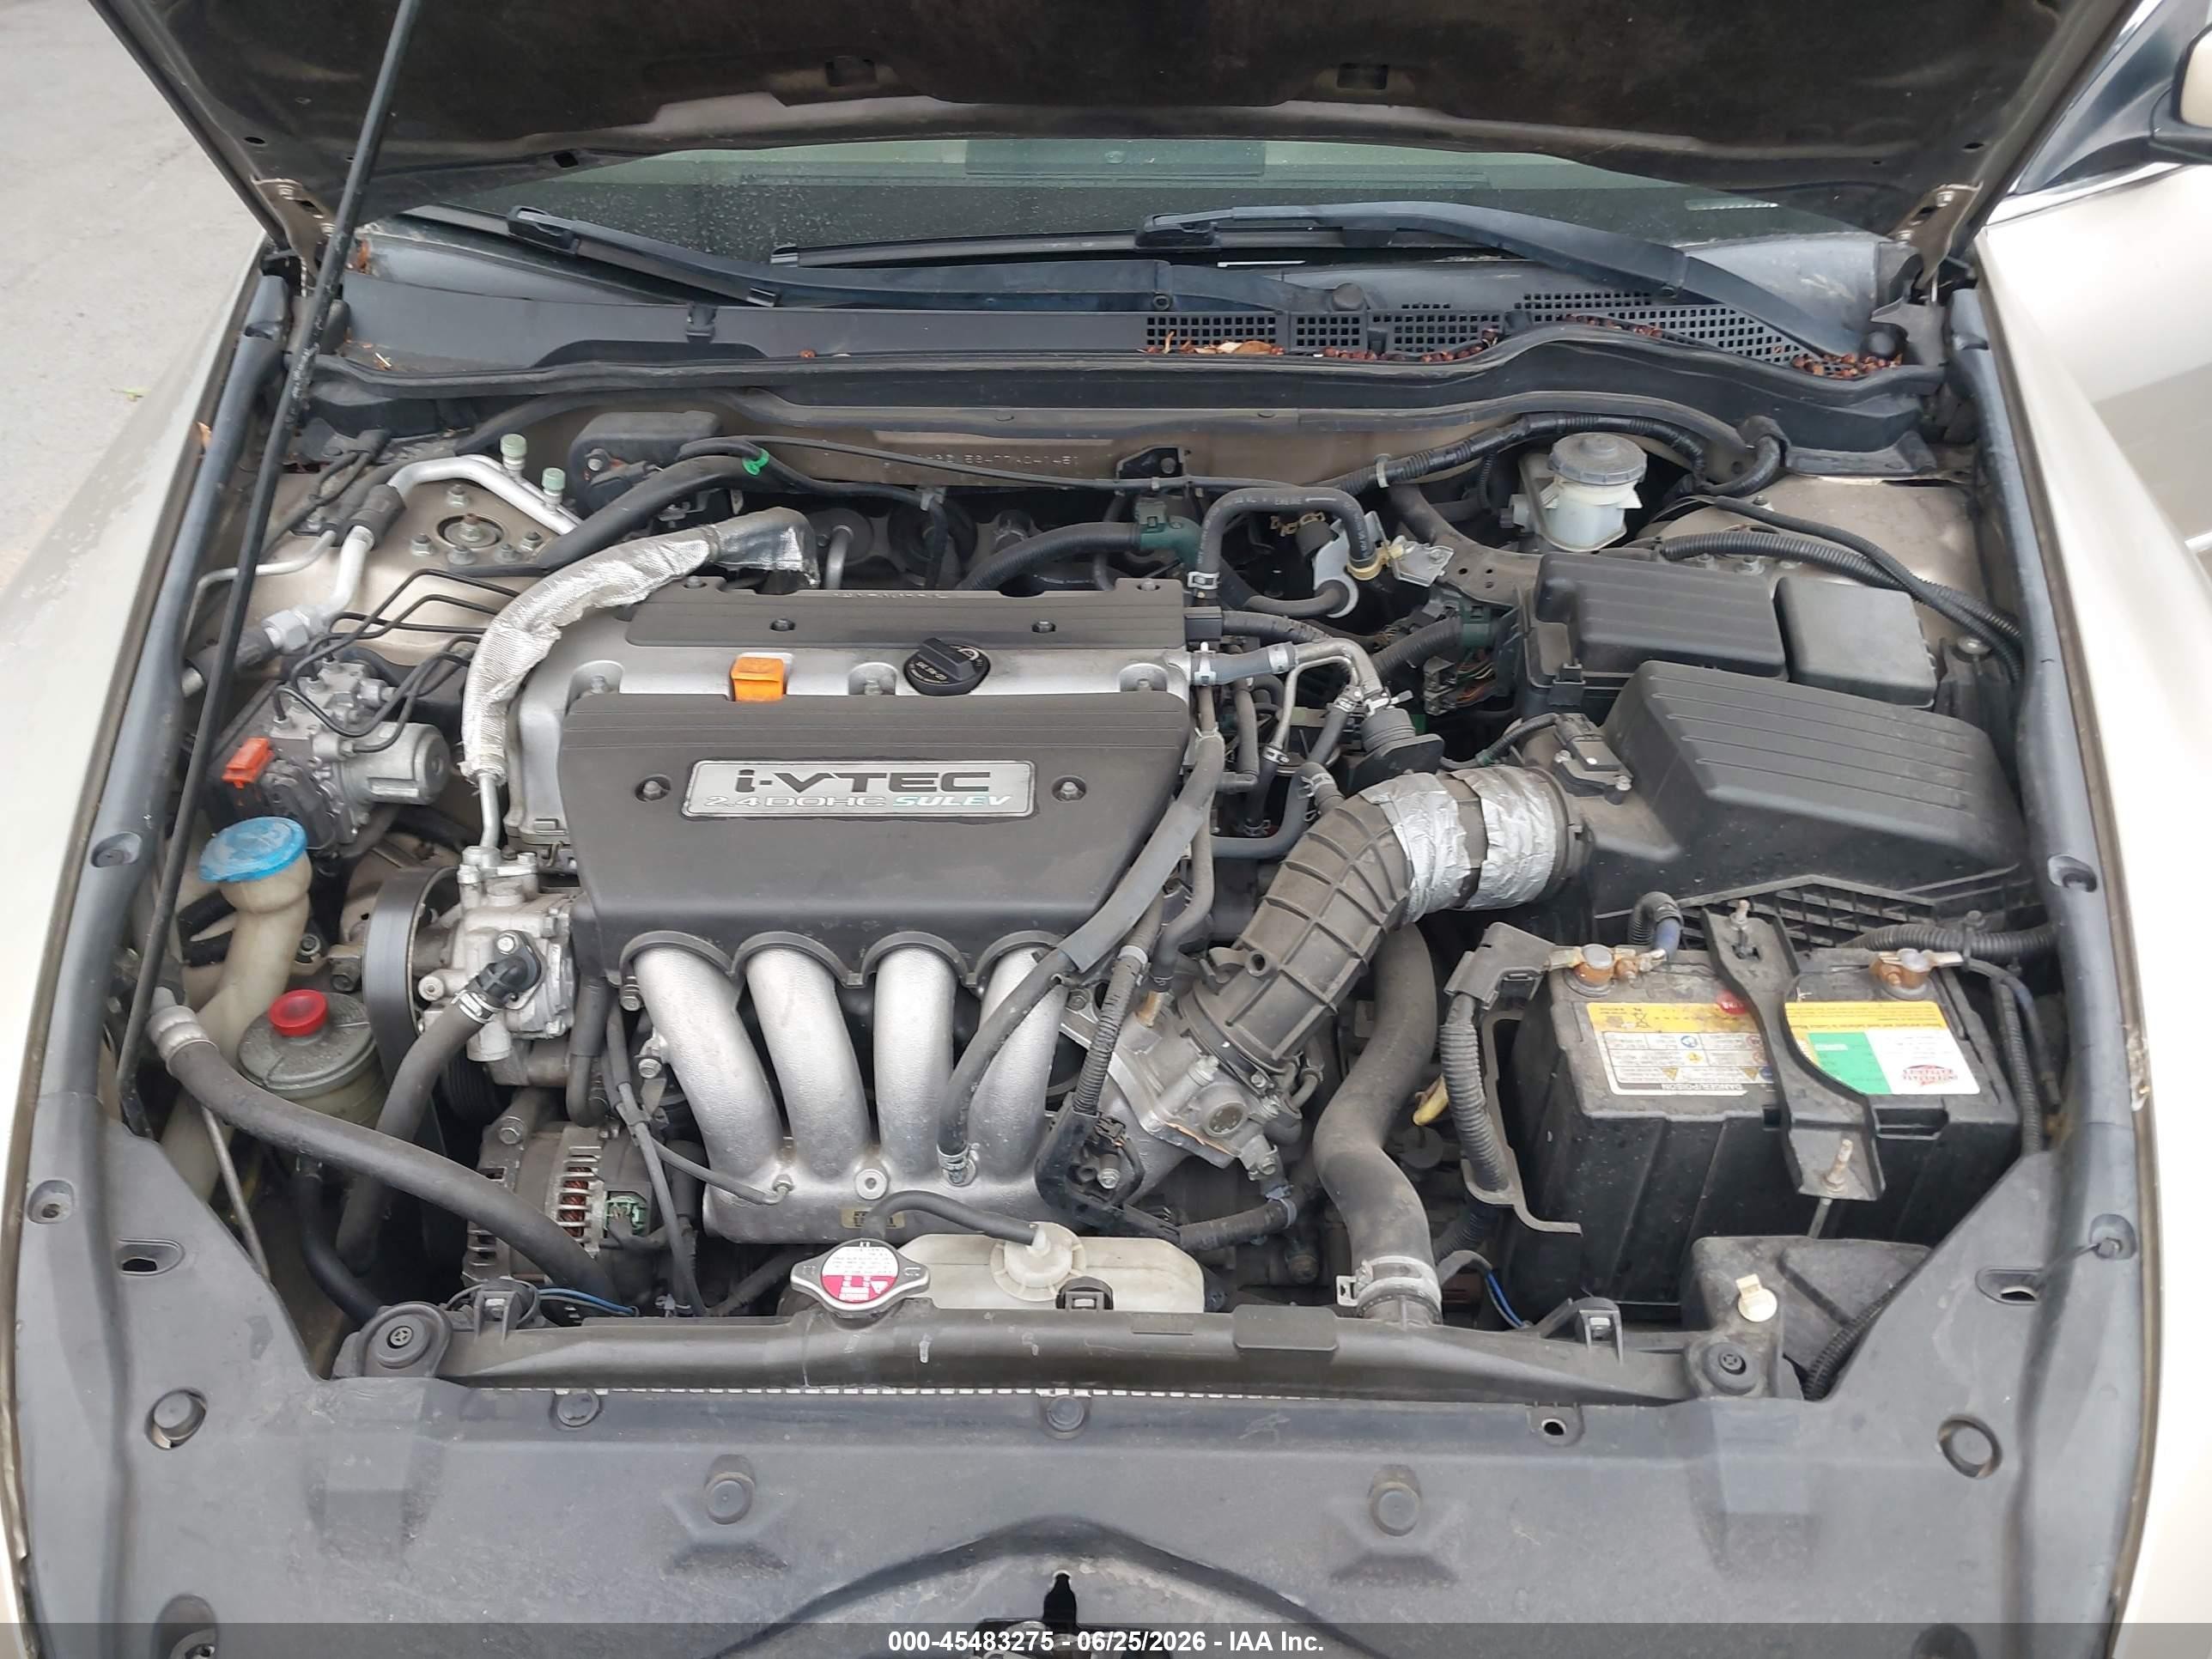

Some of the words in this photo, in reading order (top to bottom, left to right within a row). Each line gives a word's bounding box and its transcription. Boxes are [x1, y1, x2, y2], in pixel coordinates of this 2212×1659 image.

[734, 768, 990, 794] i-VTEC
[705, 795, 761, 808] 2.4
[763, 795, 886, 808] DOHC
[892, 794, 1012, 807] SULEV
